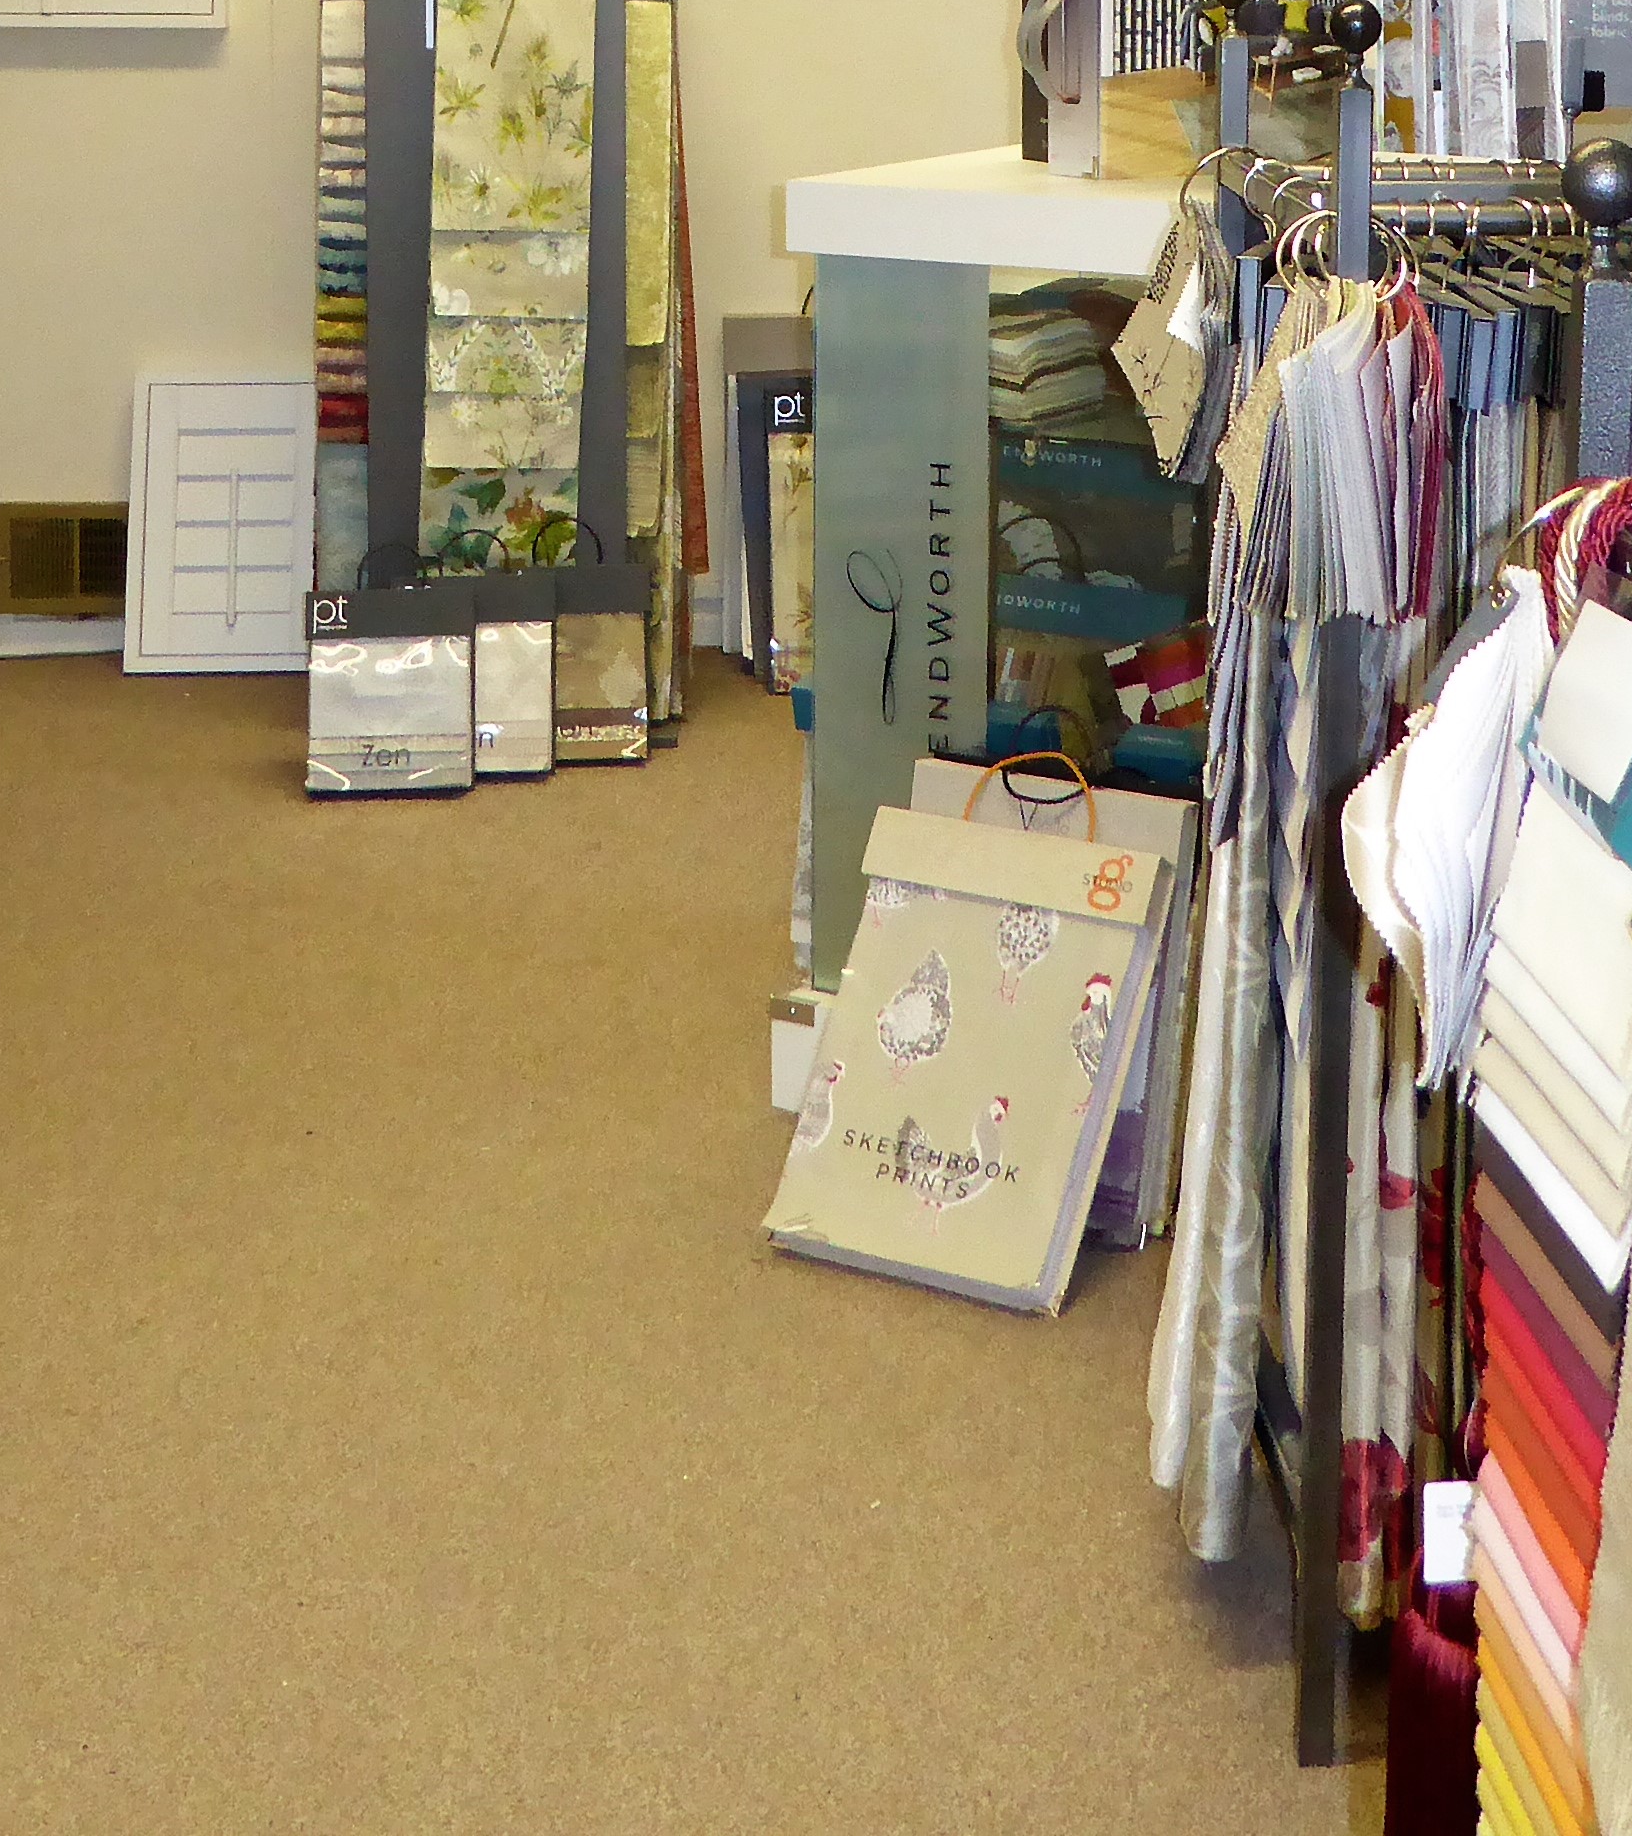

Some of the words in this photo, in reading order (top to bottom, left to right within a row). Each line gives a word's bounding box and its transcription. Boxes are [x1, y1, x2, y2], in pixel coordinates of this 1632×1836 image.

[774, 392, 805, 426] pt
[313, 596, 348, 633] pt
[361, 744, 411, 767] Zen
[843, 1128, 1021, 1183] SKETCHBOOK
[875, 1162, 970, 1199] PRINTS
